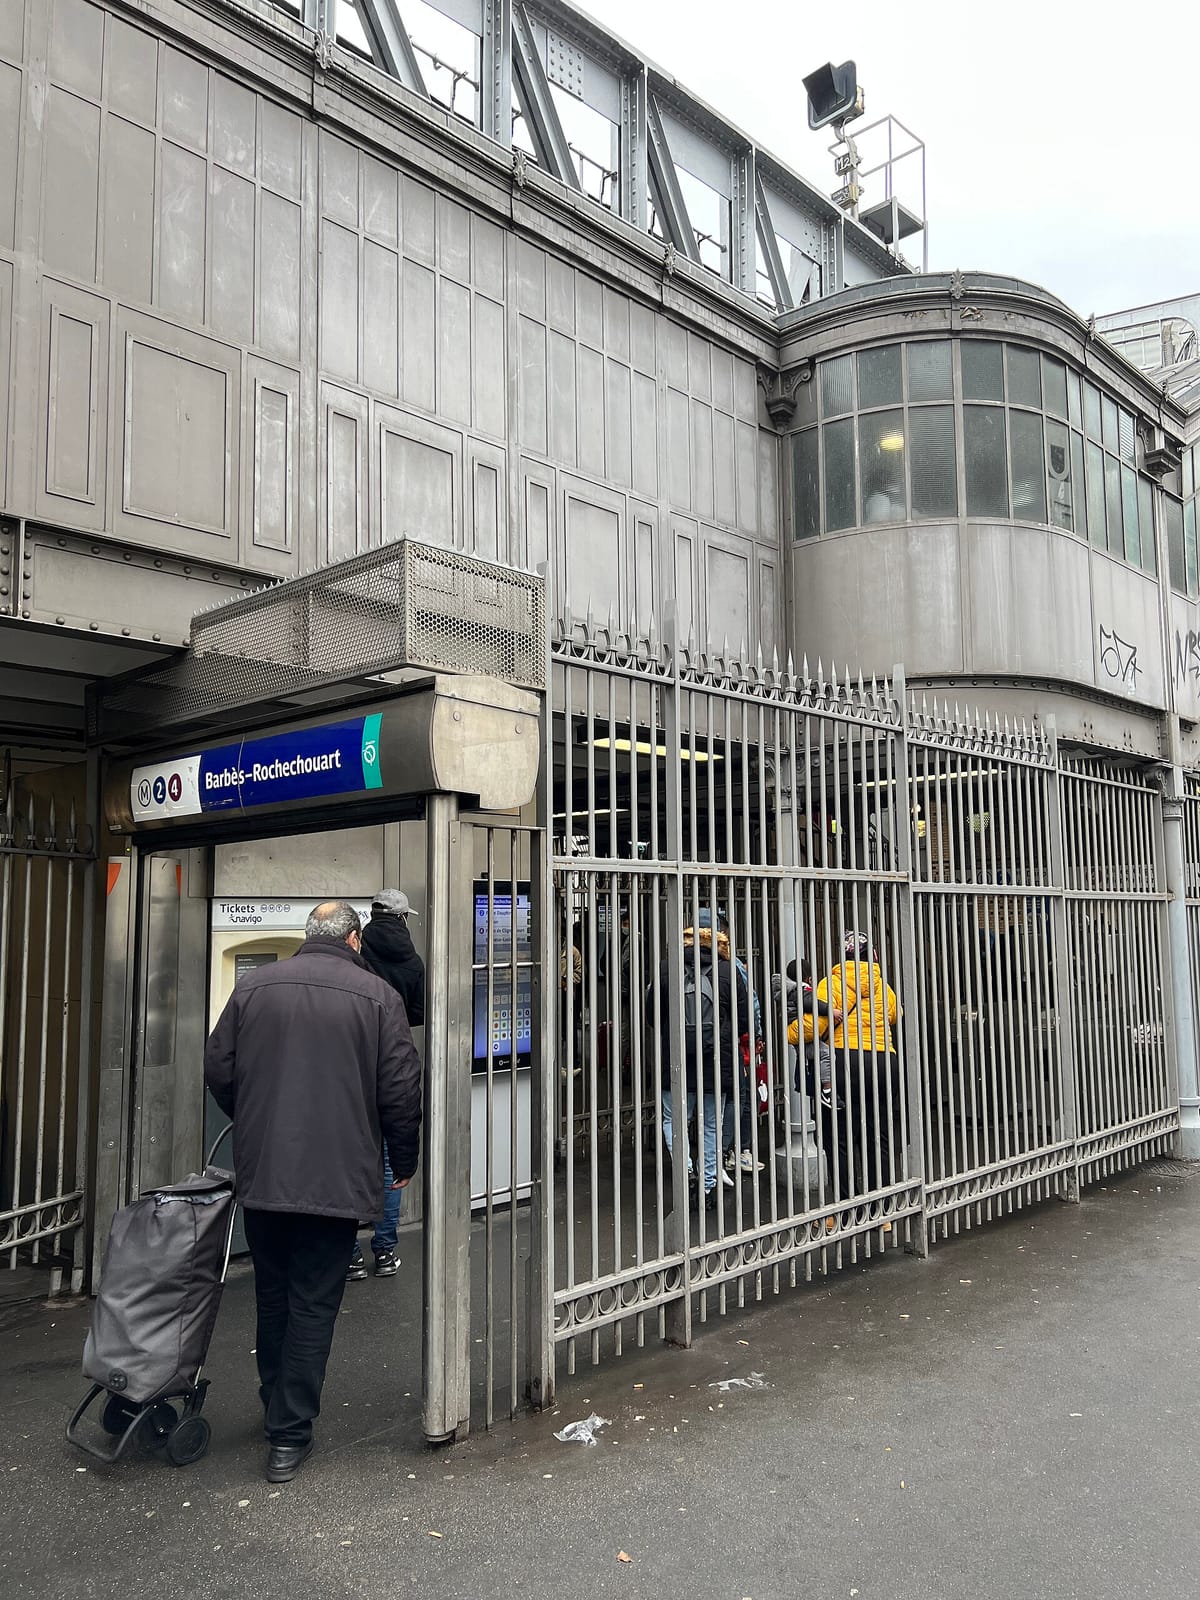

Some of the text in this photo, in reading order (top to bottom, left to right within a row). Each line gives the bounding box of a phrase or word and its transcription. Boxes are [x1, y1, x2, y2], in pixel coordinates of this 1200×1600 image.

[205, 748, 342, 790] Barbès-Rochechouart
[220, 903, 255, 913] Tickets
[232, 914, 263, 925] navigo
